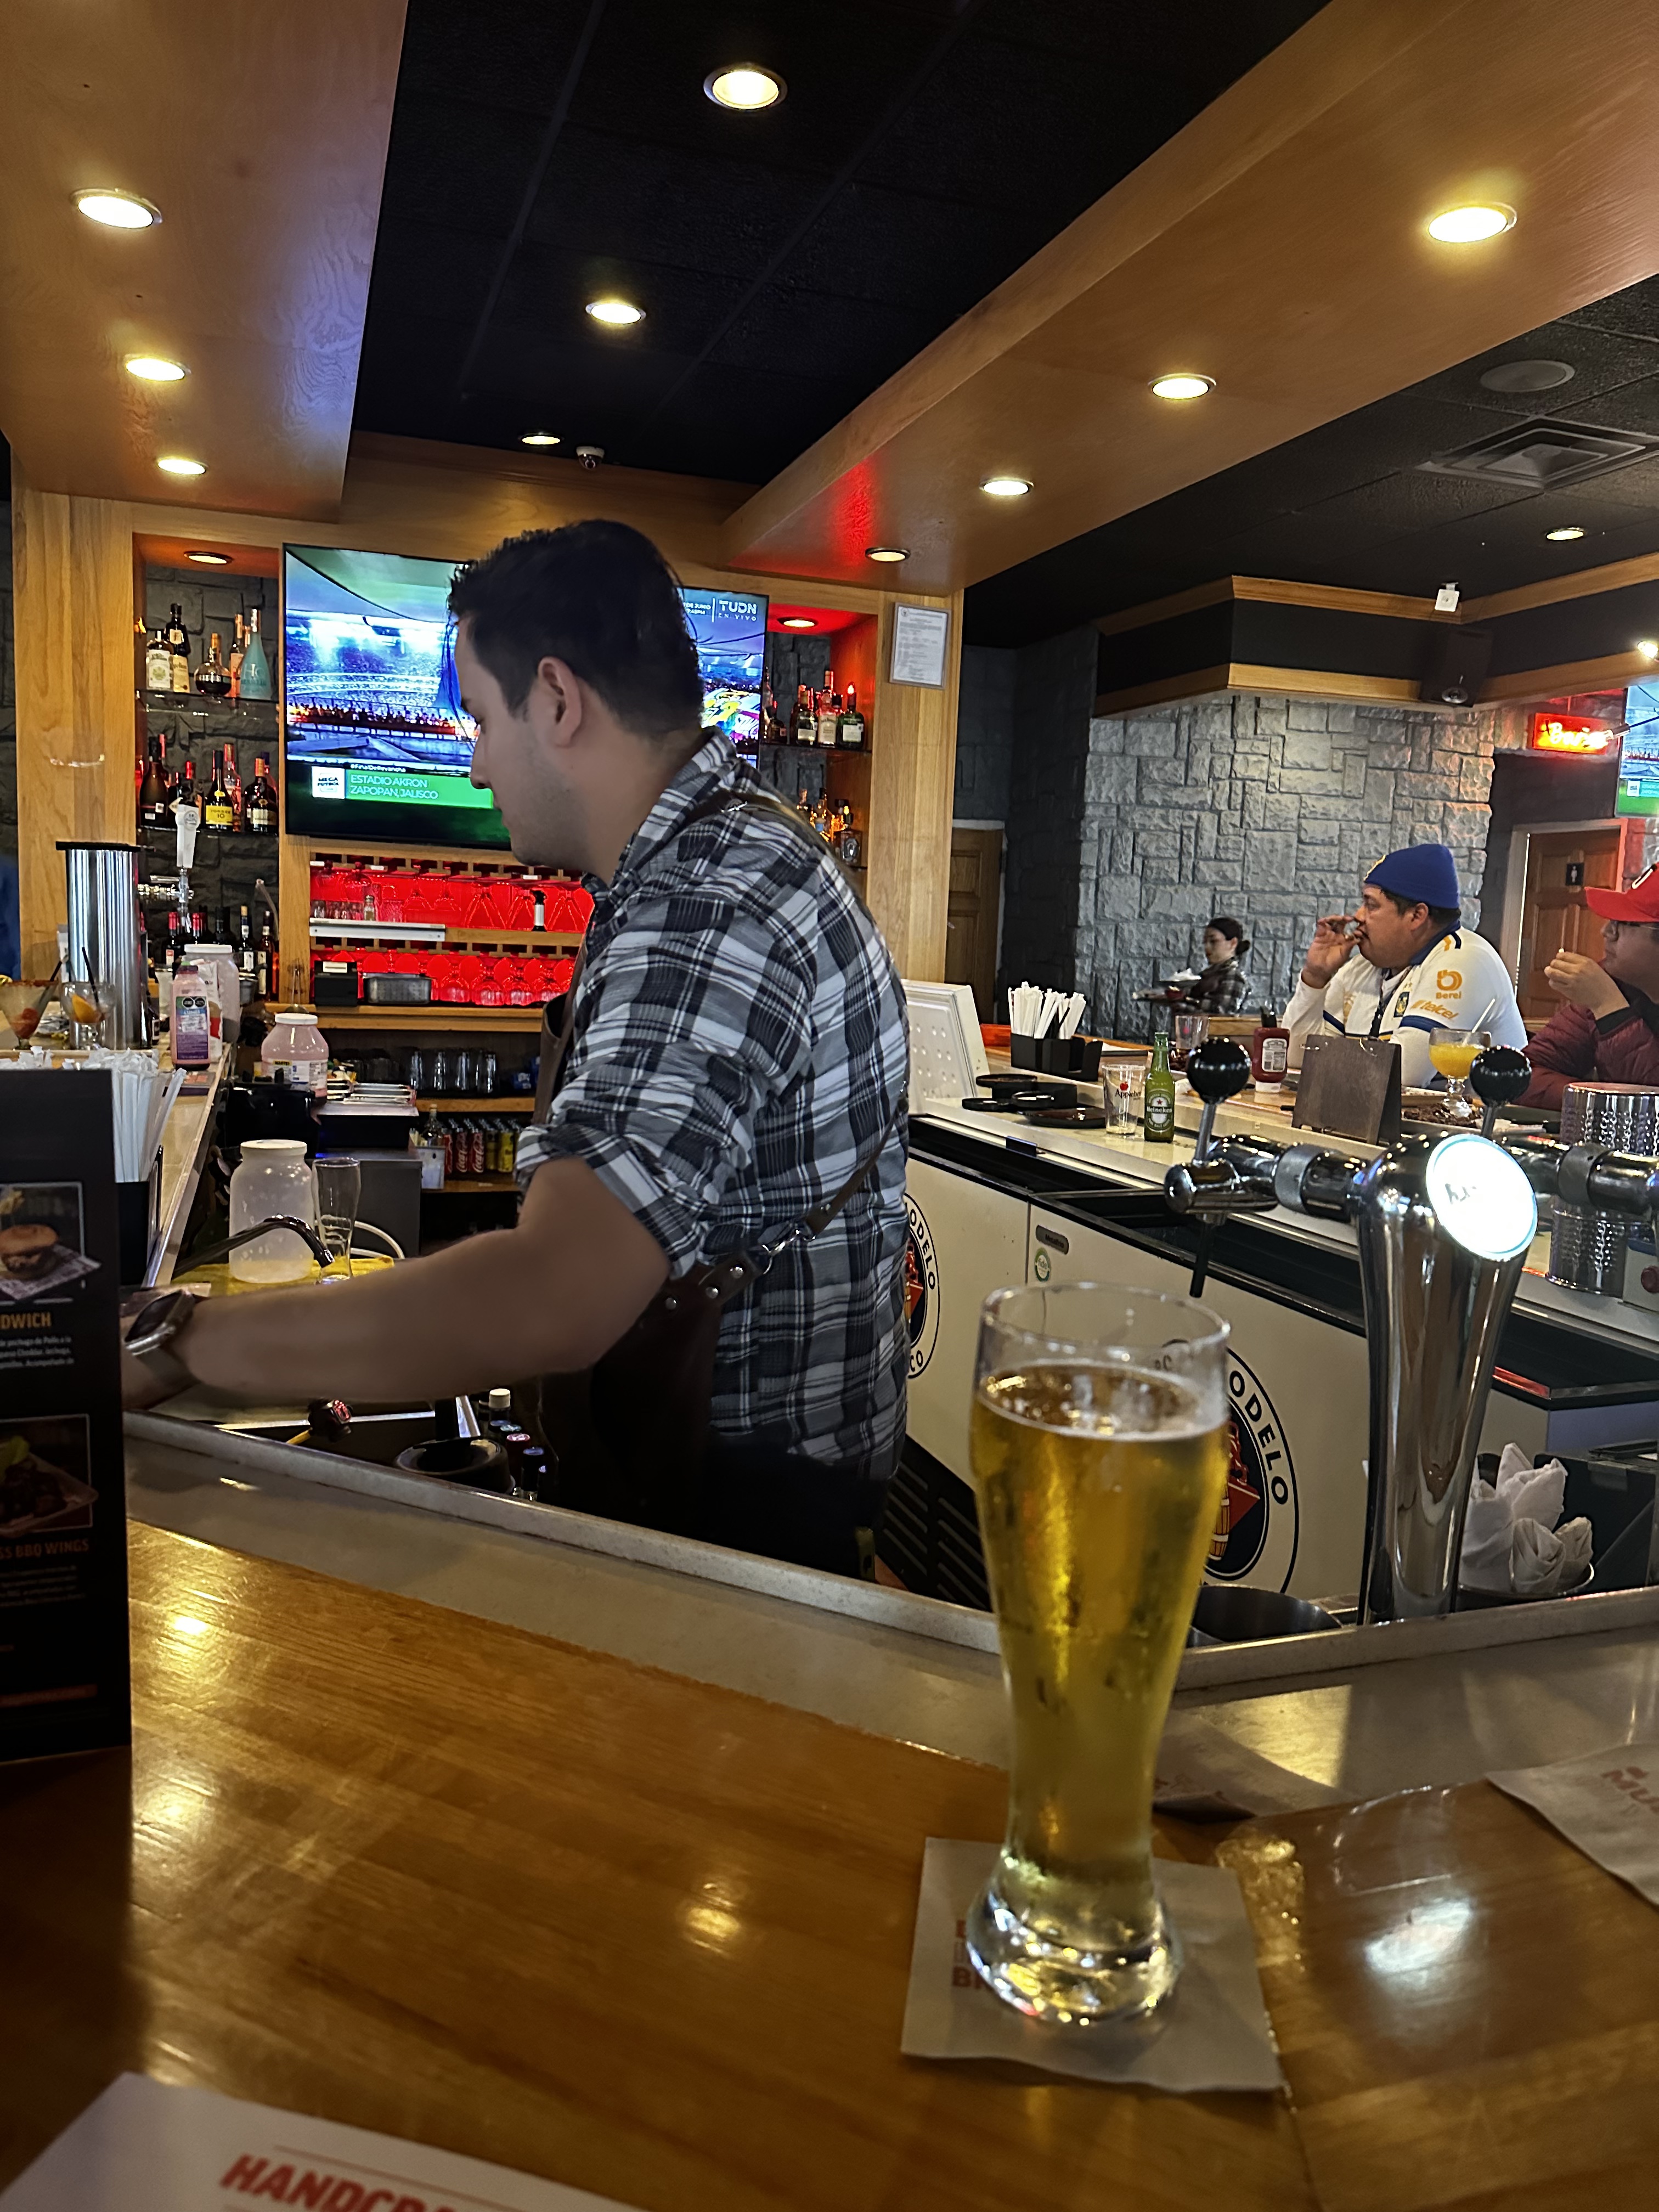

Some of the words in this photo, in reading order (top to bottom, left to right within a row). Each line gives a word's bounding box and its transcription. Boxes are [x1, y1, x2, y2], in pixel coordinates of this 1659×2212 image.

[719, 600, 757, 614] TUDN
[350, 774, 392, 786] ESTADIO
[392, 776, 428, 788] AKRON
[400, 789, 439, 800] JALISCO
[1435, 991, 1462, 1000] Berel
[1420, 1000, 1459, 1020] telcel
[909, 1208, 936, 1290] ODELO
[1228, 1369, 1289, 1506] ODELO
[15, 1543, 43, 1558] BBQ
[44, 1538, 90, 1555] WINGS
